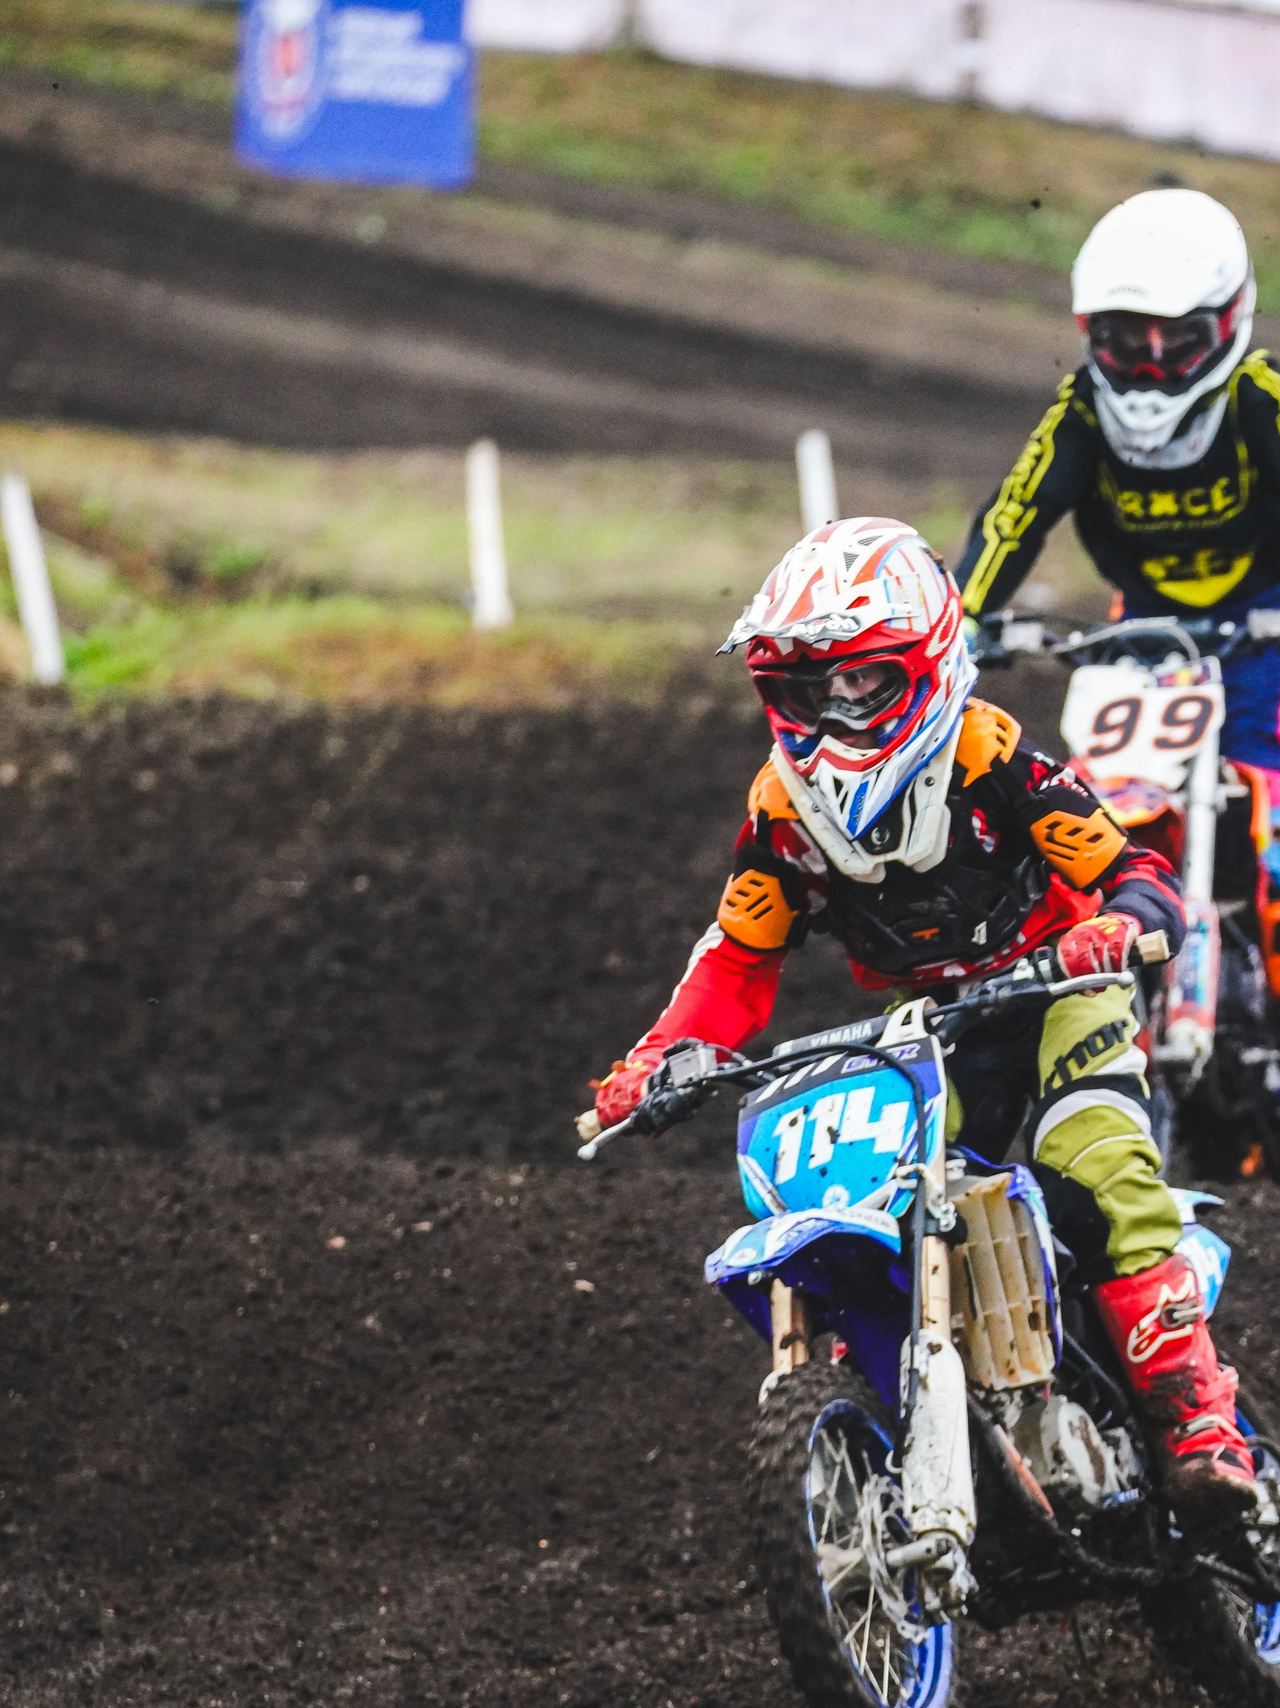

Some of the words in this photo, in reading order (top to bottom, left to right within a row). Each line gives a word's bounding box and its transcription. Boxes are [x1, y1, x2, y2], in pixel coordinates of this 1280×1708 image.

[1086, 694, 1216, 759] 99
[809, 1021, 873, 1047] YAMAHA
[772, 1086, 910, 1186] 114
